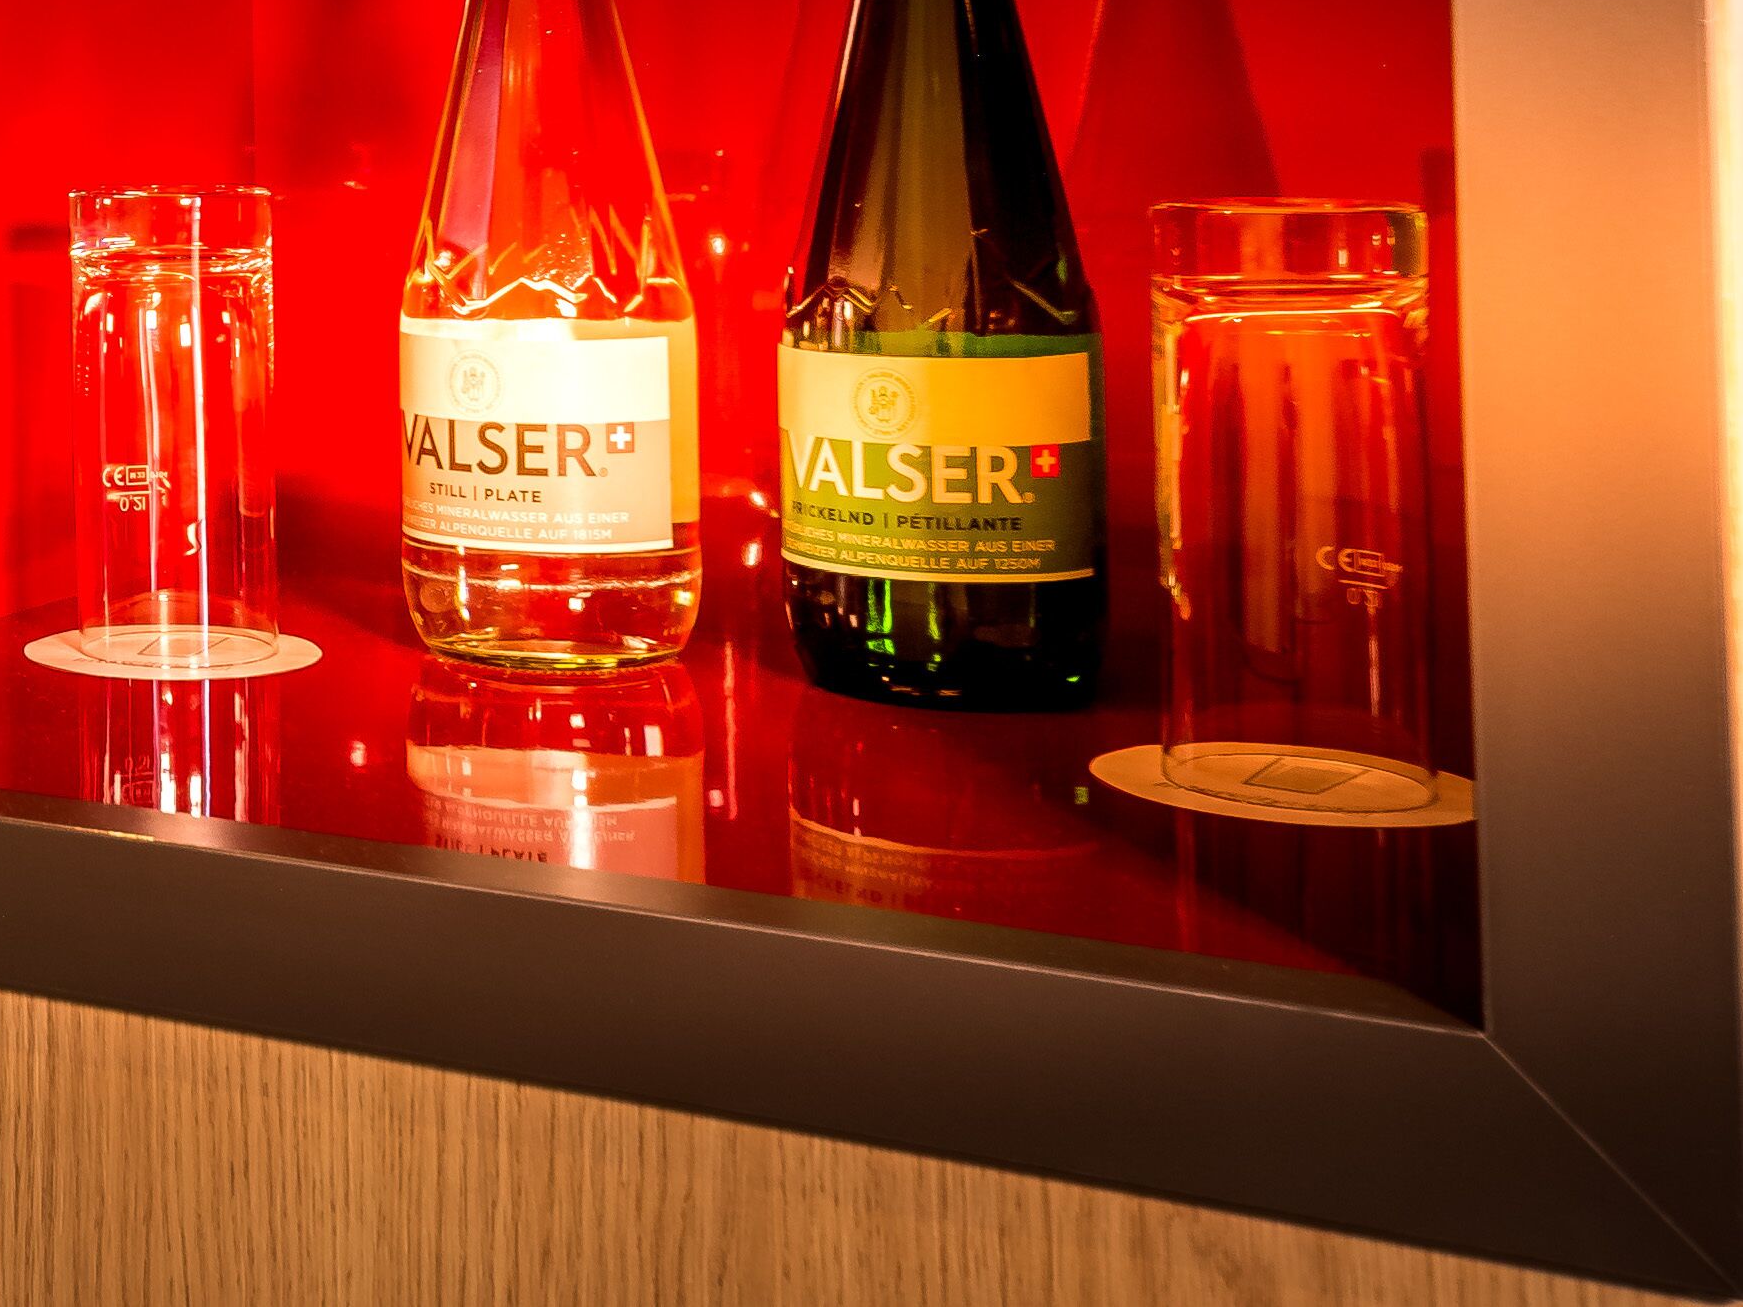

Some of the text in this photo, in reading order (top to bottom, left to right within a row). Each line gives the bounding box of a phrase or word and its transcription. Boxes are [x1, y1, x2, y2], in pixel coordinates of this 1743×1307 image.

[403, 409, 597, 477] VALSER
[787, 427, 1023, 504] VALSER
[428, 482, 542, 503] STILL PLATE
[436, 504, 548, 524] MINERALWASSER
[553, 511, 584, 525] AUS
[588, 511, 631, 525] EINER
[897, 511, 1023, 532] PÉTILLANTE
[439, 522, 533, 540] ALPENQUELLE
[537, 527, 569, 539] AUF
[573, 528, 613, 540] 1815M
[836, 532, 970, 553] MINERALWASSER
[974, 540, 1009, 553] AUS
[1011, 539, 1057, 553] EINER
[839, 550, 951, 569] ALPENQUELLE
[956, 557, 990, 569] AUF
